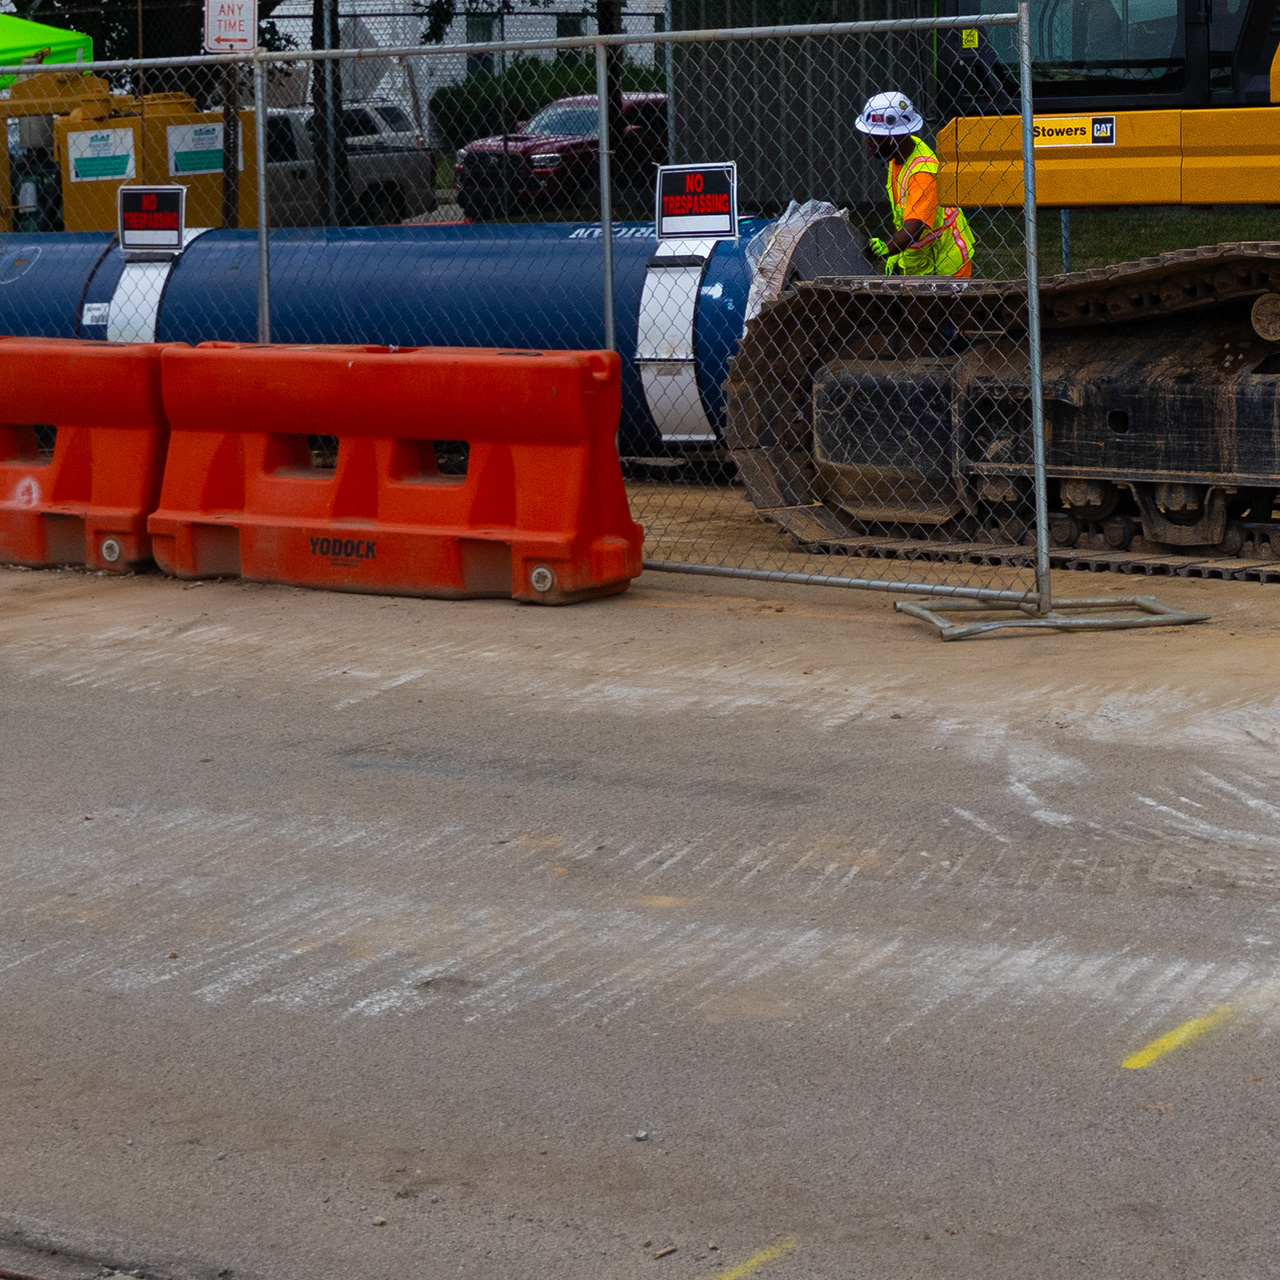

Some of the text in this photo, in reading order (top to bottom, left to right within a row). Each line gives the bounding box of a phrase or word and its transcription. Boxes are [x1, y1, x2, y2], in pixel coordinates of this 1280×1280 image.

[218, 4, 244, 16] ANY
[216, 19, 245, 32] TIME
[1033, 123, 1112, 138] Stowers CAT
[685, 173, 704, 193] NO
[142, 194, 157, 210] NO
[663, 193, 729, 215] TRESPASSING
[310, 536, 377, 560] YODOCK
